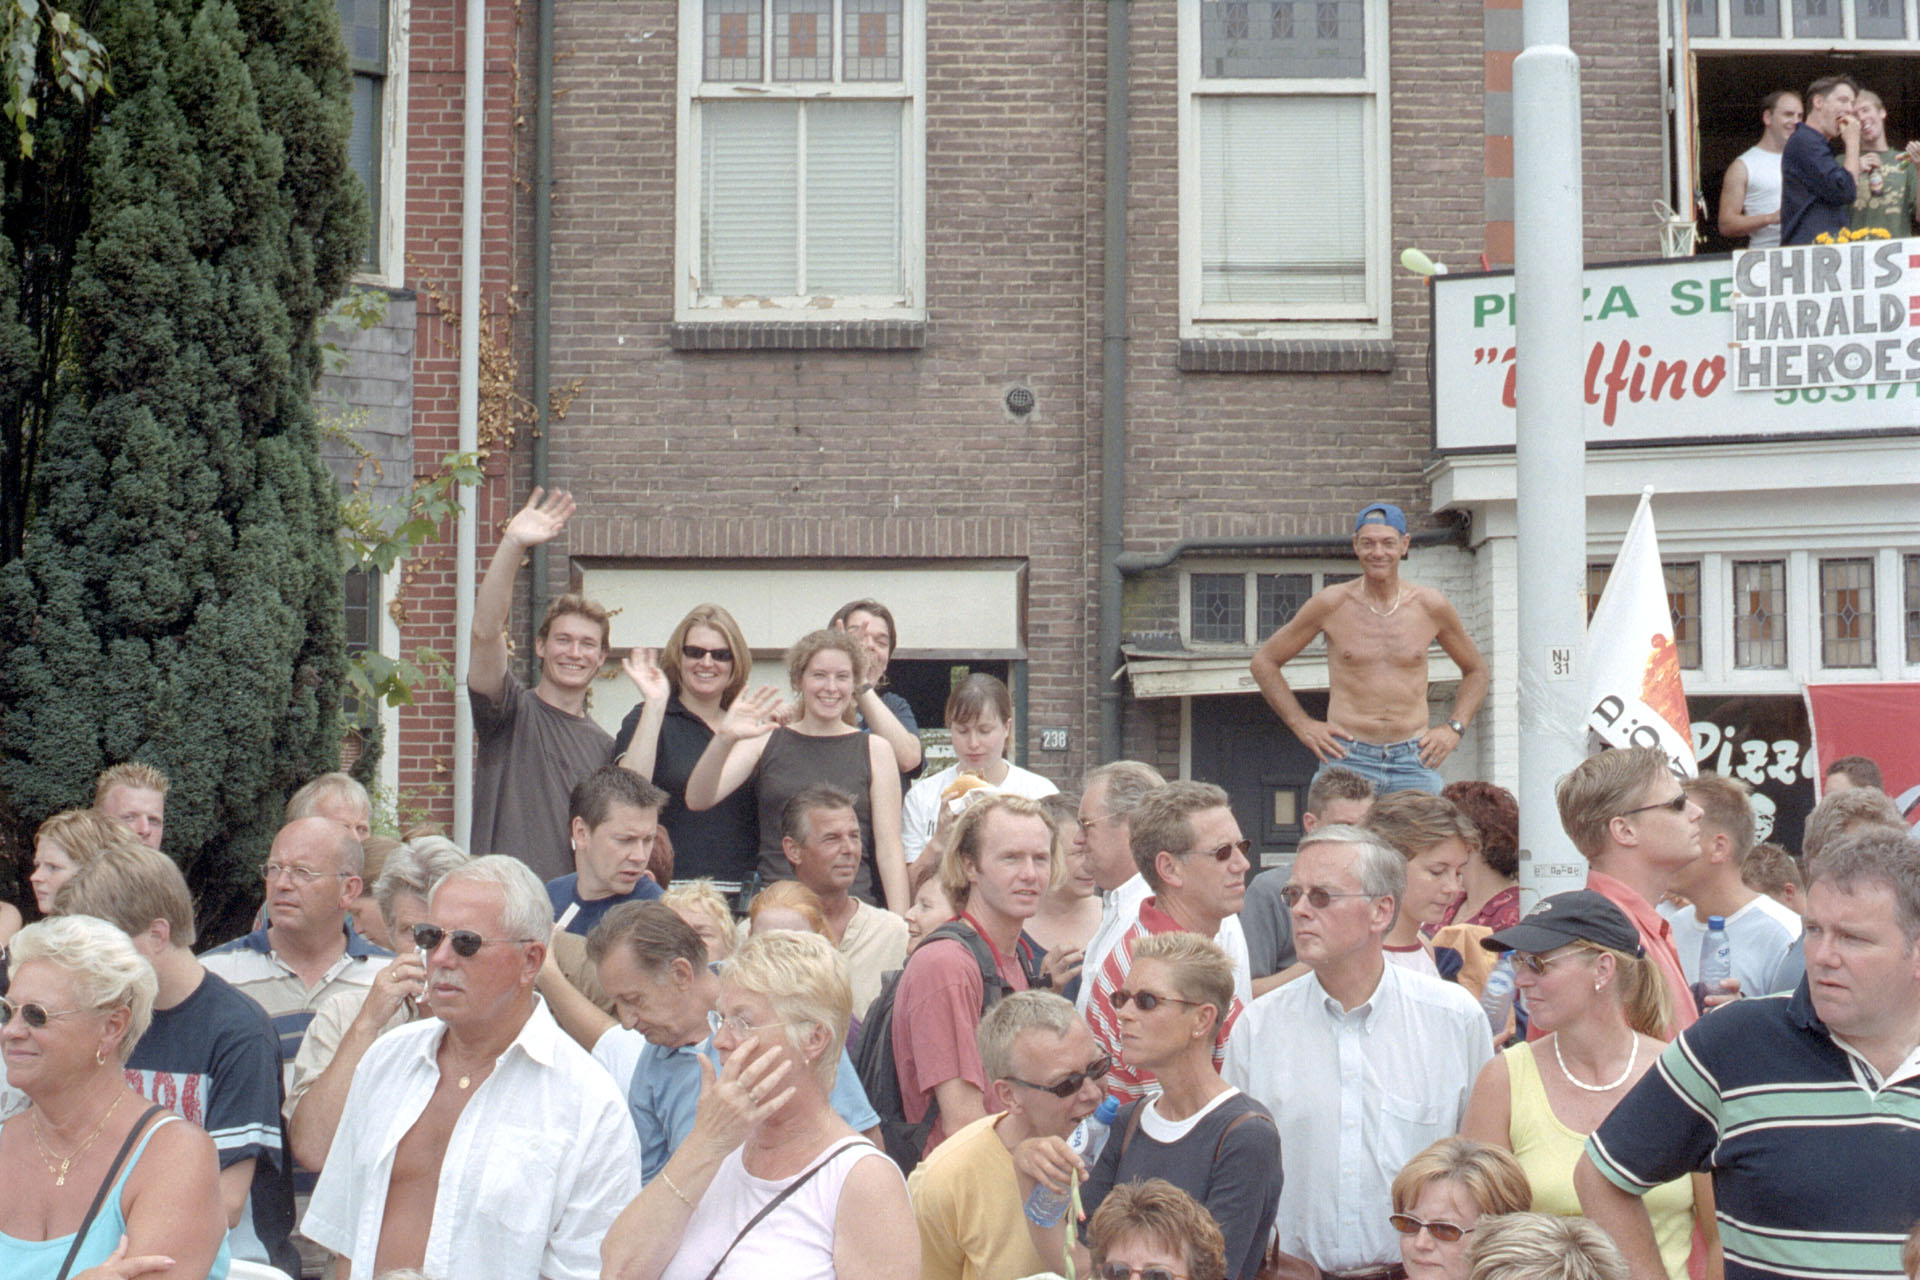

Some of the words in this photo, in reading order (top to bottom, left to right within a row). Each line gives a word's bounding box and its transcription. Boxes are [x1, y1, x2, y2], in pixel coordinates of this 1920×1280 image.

[1736, 242, 1903, 297] CHRIS
[1474, 285, 1640, 328] PIA
[1736, 293, 1906, 341] HARALD
[1552, 649, 1570, 662] NJ
[1553, 662, 1569, 676] 31
[1043, 731, 1067, 748] 238
